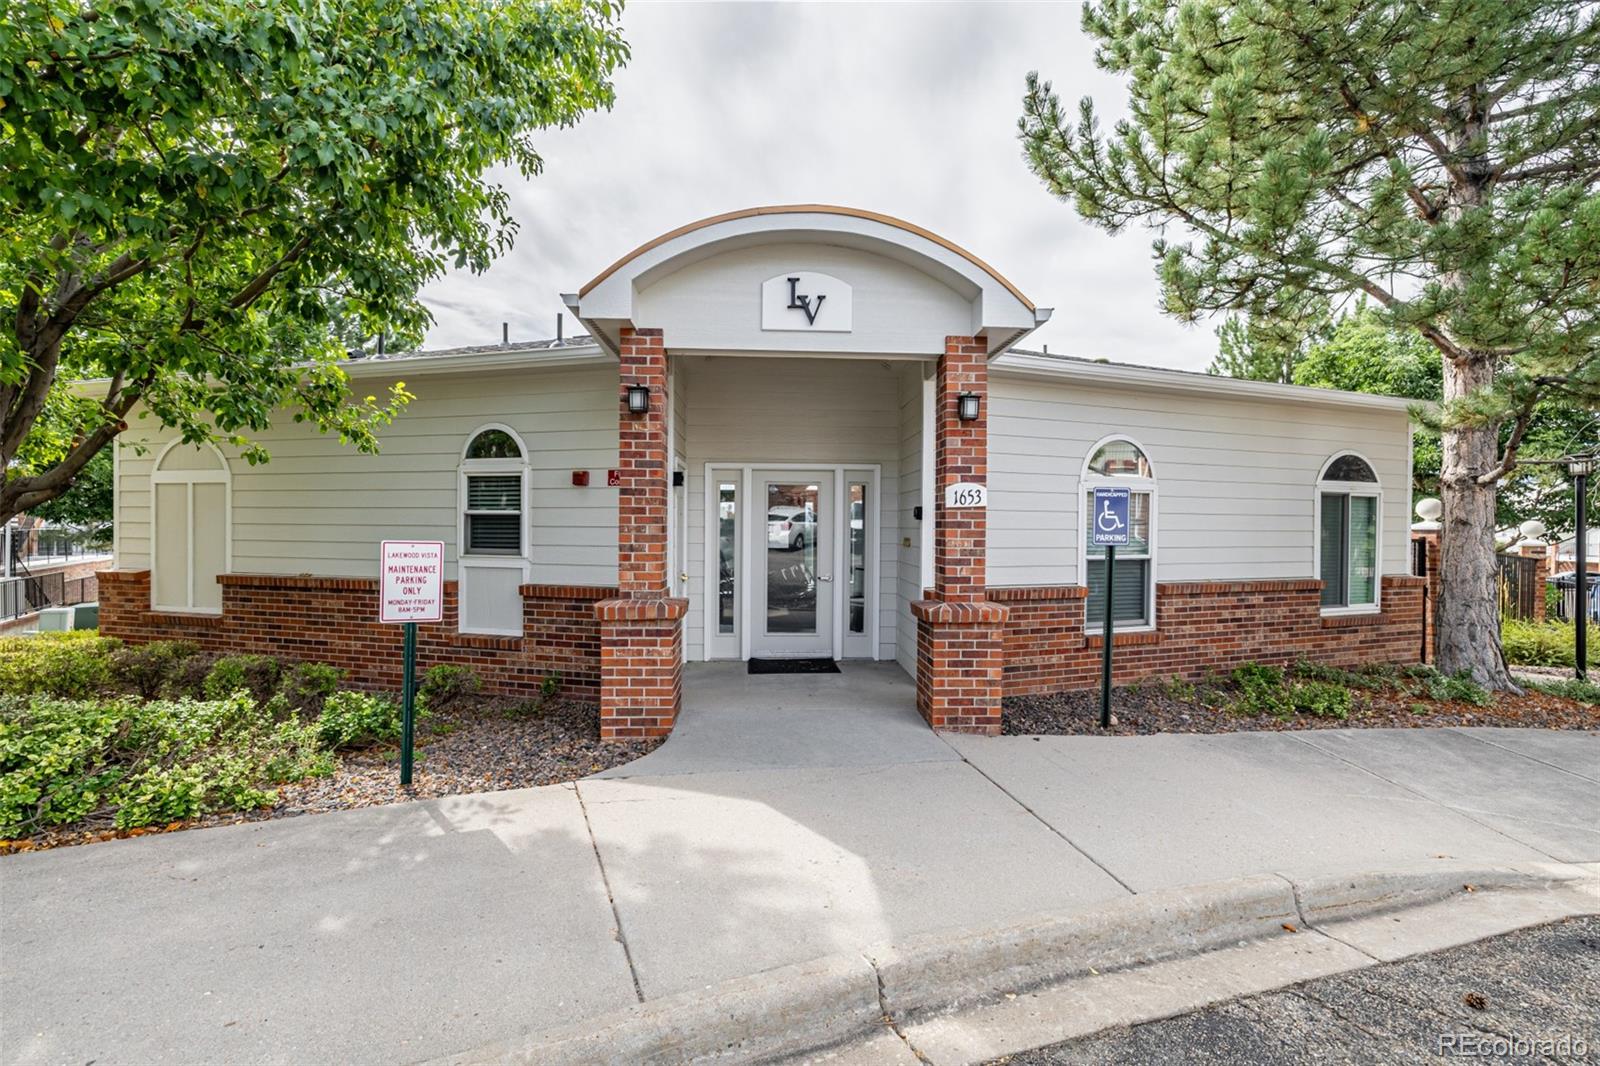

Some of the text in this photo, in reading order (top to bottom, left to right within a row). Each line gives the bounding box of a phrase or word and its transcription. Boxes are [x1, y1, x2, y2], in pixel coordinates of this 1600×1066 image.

[954, 489, 982, 505] 1653
[388, 565, 437, 574] MAINTENANCE
[395, 576, 427, 584] PARKING
[402, 587, 421, 595] ONLY
